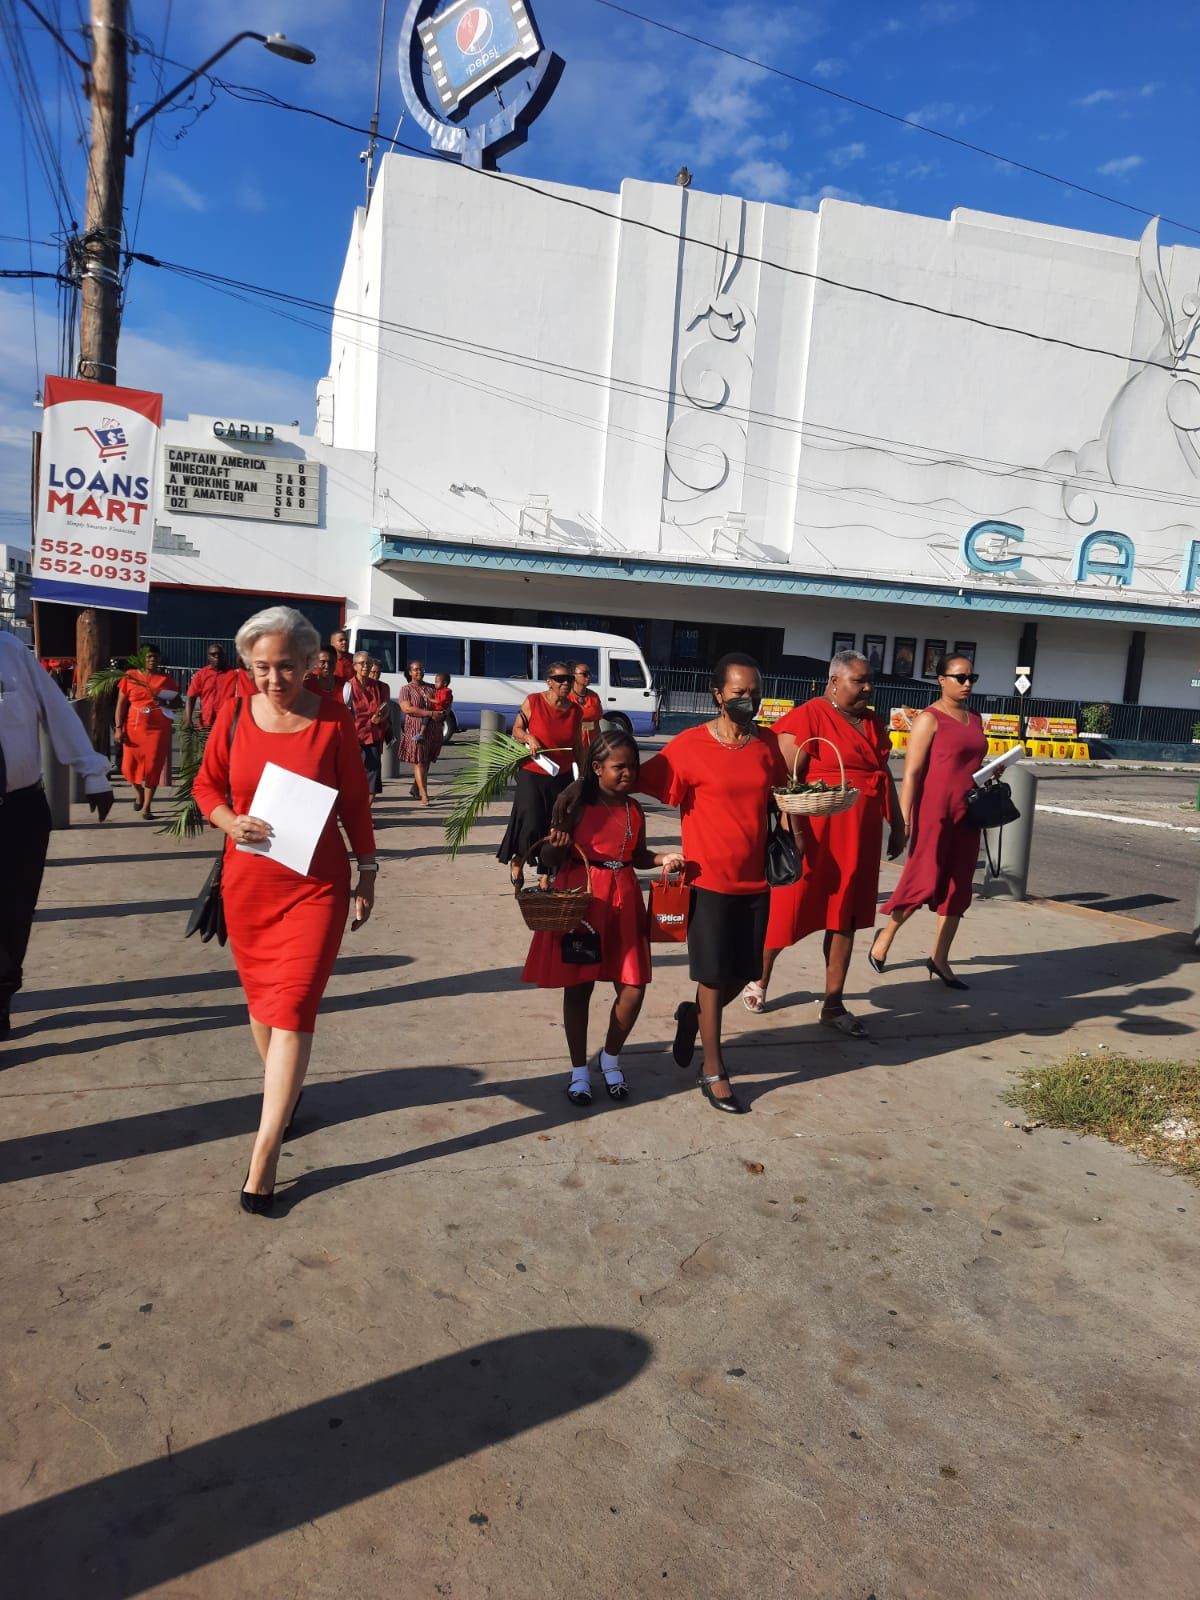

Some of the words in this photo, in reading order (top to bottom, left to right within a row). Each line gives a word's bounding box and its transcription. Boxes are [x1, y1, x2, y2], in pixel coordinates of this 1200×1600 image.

[466, 46, 500, 76] pepsi
[213, 421, 275, 441] CARIB
[168, 450, 217, 466] CAPTAIN
[221, 455, 266, 471] AMERICA
[298, 464, 305, 474] 8
[169, 462, 231, 478] MINECRAFT
[276, 474, 283, 484] 5
[287, 475, 293, 485] &
[299, 476, 306, 486] 8
[48, 463, 150, 500] LOANS
[169, 473, 177, 484] A
[183, 475, 230, 490] WORKING
[235, 481, 258, 493] MAN
[275, 485, 282, 495] 5
[286, 486, 293, 496] &
[299, 487, 306, 497] 8
[47, 489, 148, 526] MART
[165, 485, 186, 497] THE
[193, 486, 244, 503] AMATEUR
[275, 497, 282, 507] 5
[286, 497, 292, 507] &
[298, 498, 305, 509] 8
[170, 497, 188, 509] OZI
[274, 508, 281, 518] 5
[40, 538, 147, 565] 552-0955
[39, 557, 146, 584] 552-0933
